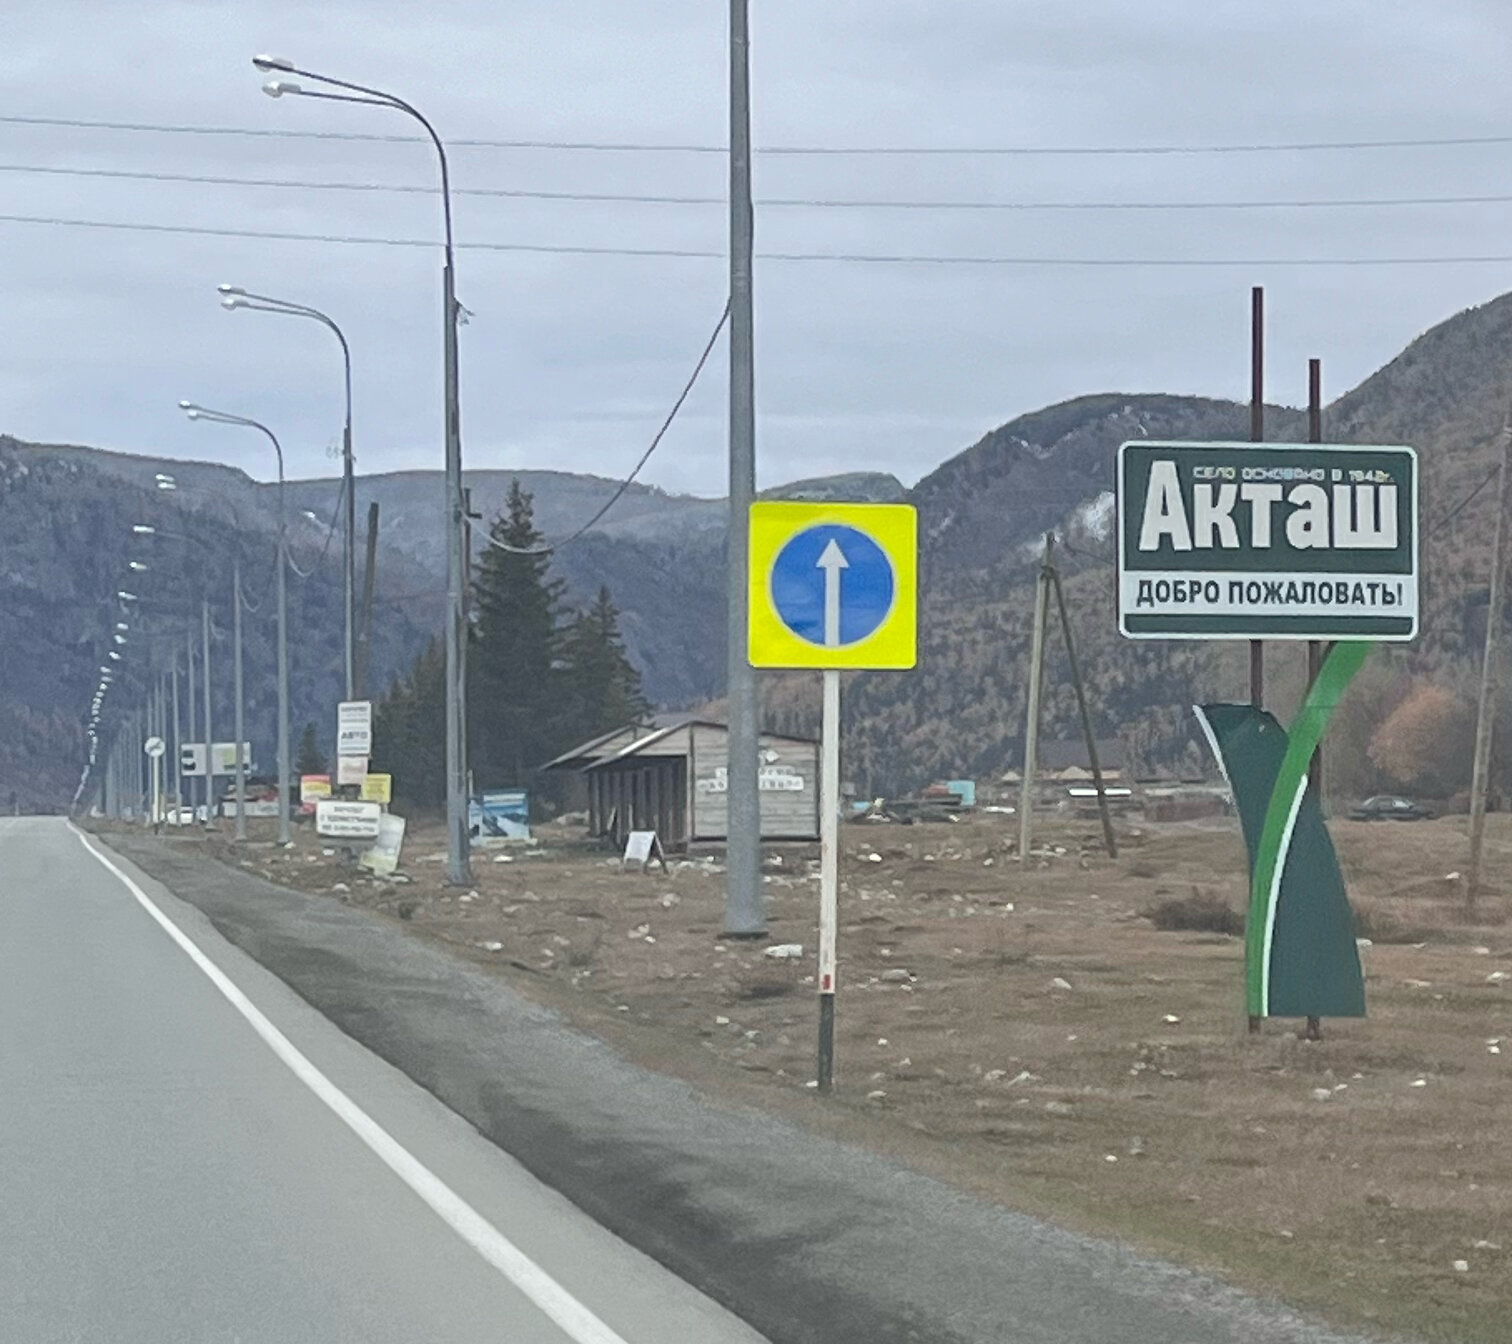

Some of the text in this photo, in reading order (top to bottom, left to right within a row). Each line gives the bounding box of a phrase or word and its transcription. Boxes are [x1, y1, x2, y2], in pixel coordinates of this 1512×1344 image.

[1138, 460, 1398, 551] Акташ
[1136, 579, 1403, 607] ДОБРО ПОЖАЛОВАТЬ!
